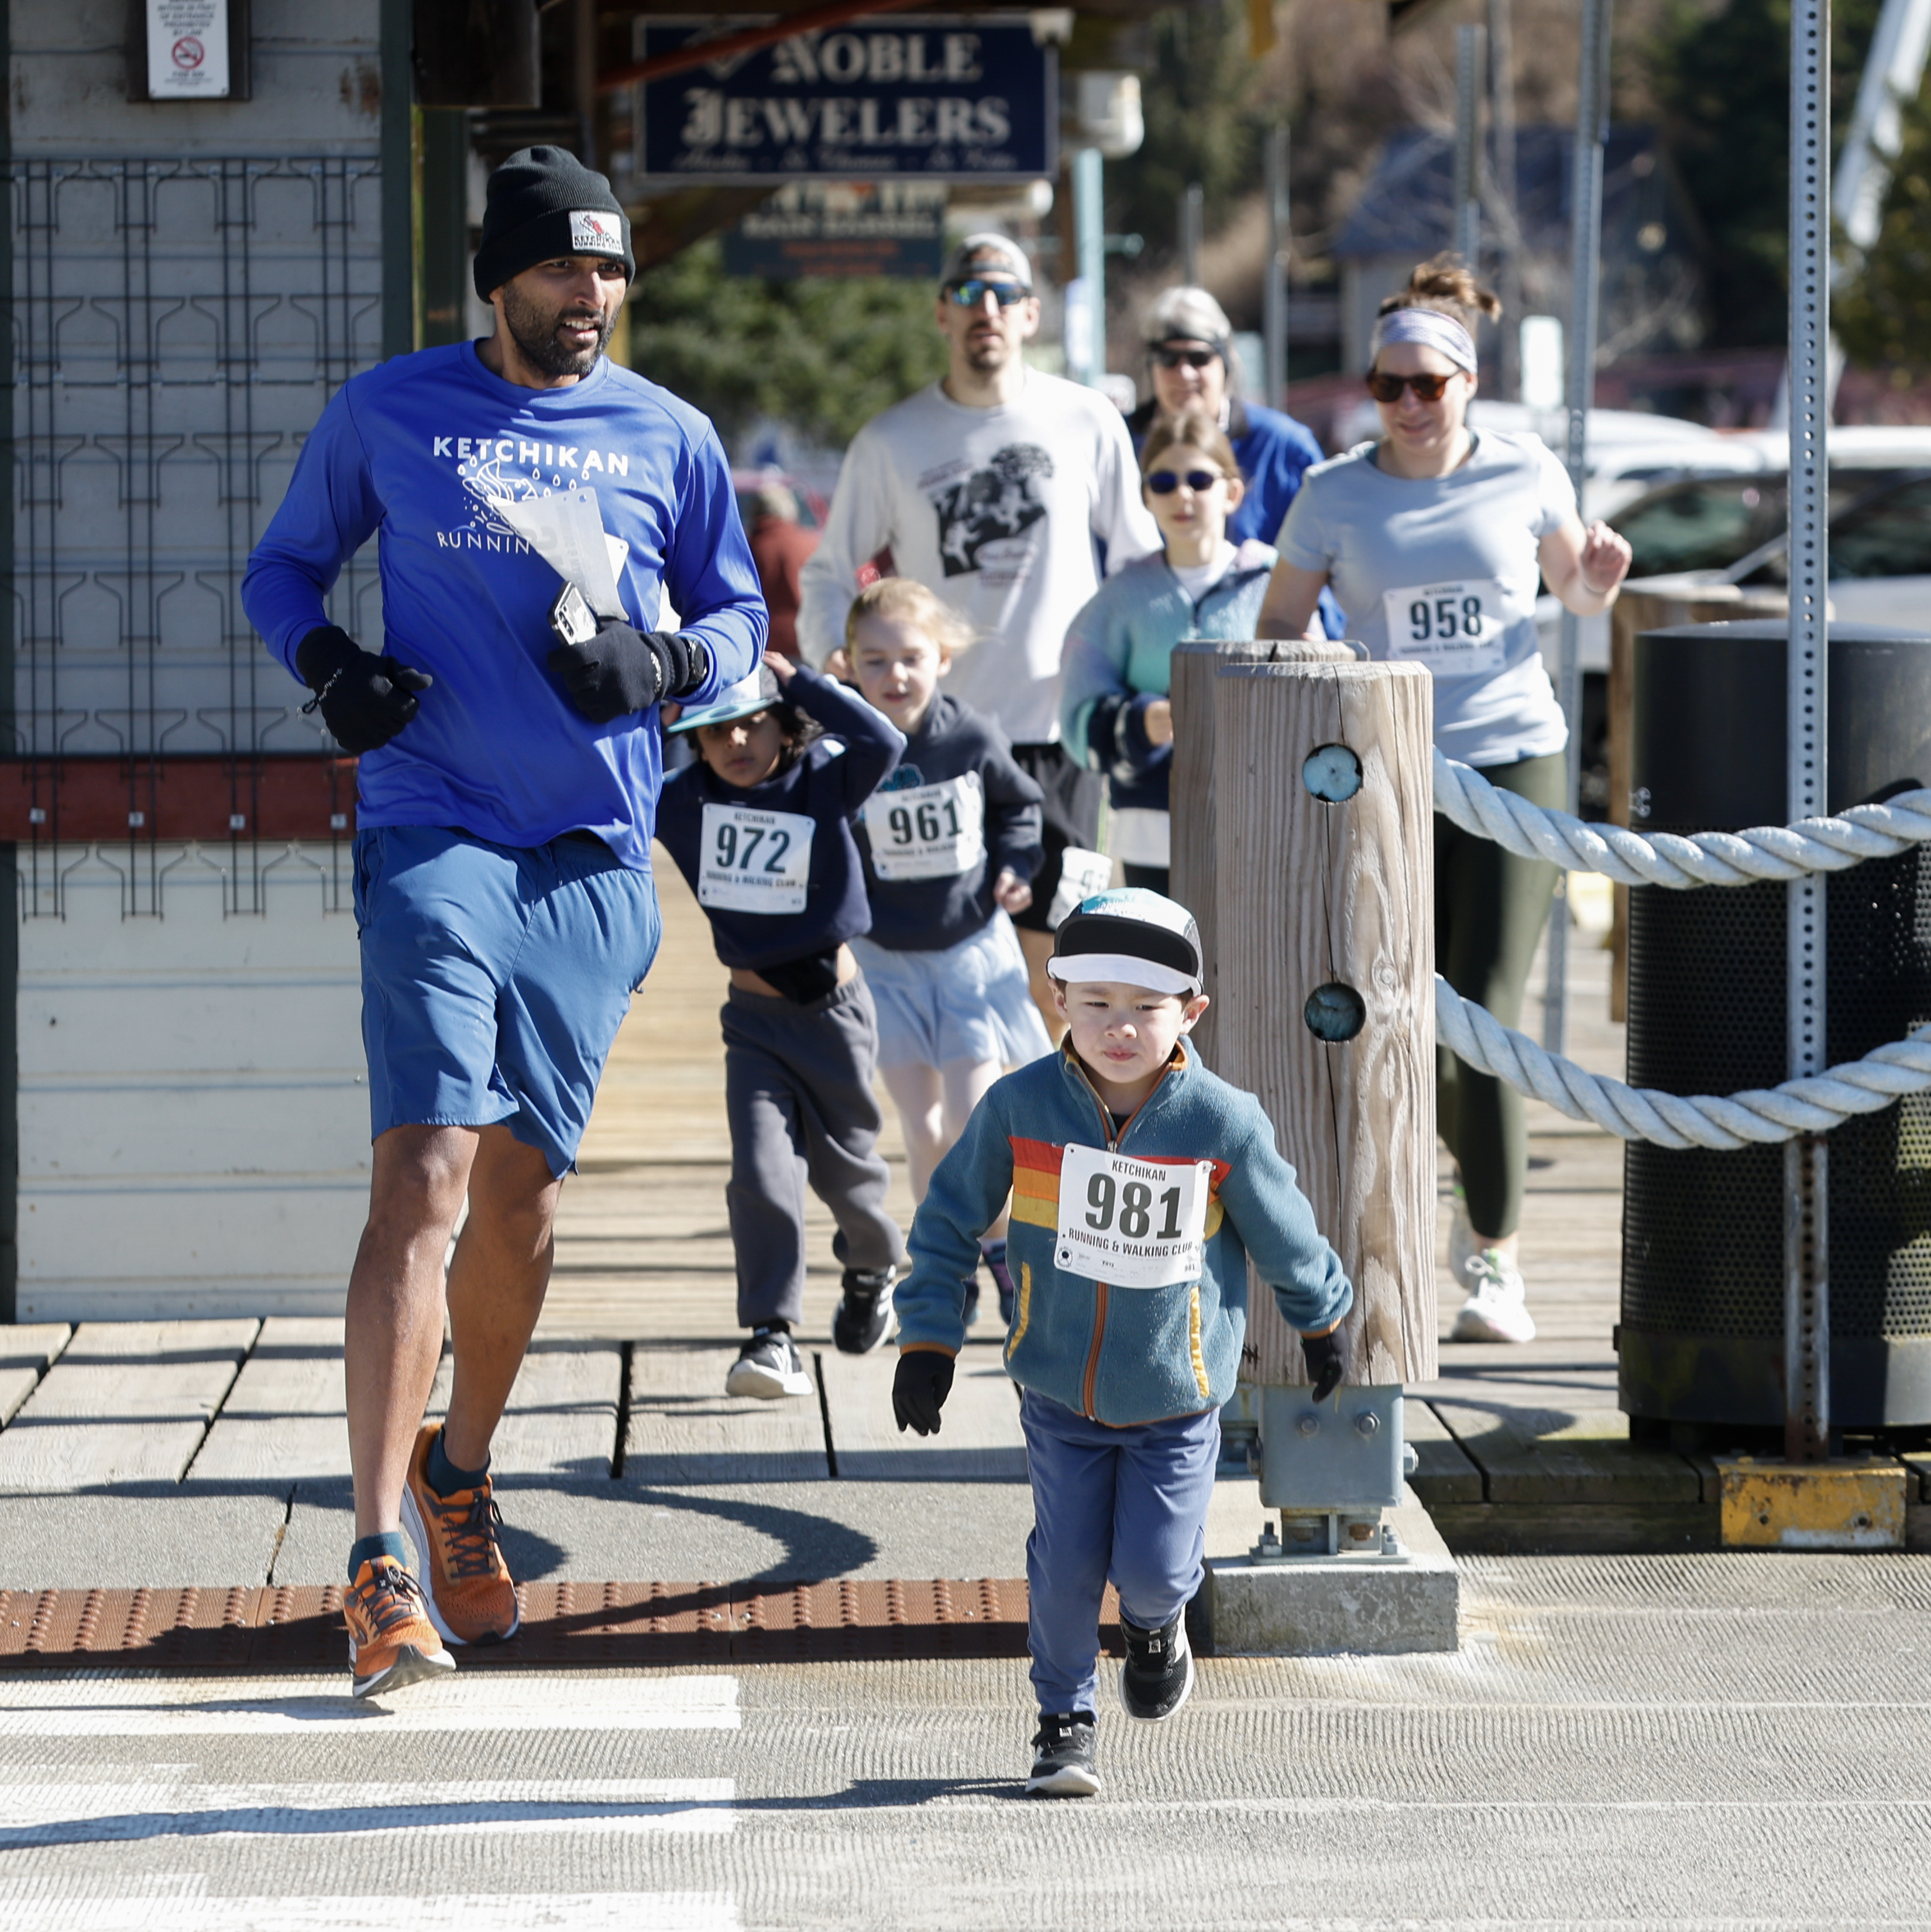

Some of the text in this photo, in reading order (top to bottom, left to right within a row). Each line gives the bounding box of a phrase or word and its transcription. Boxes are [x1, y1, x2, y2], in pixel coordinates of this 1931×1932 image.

[771, 29, 984, 84] NOBLE
[681, 87, 1011, 147] JEWELERS
[434, 437, 628, 476] KETCHIKAN
[437, 531, 530, 554] RUNNIN
[1410, 596, 1482, 640] 958
[889, 799, 963, 845] 961
[716, 823, 791, 873] 972
[1112, 1159, 1166, 1182] KETCHIKAN
[1085, 1173, 1182, 1239] 981
[1069, 1228, 1193, 1257] RUNNING & WALKING CLUB
